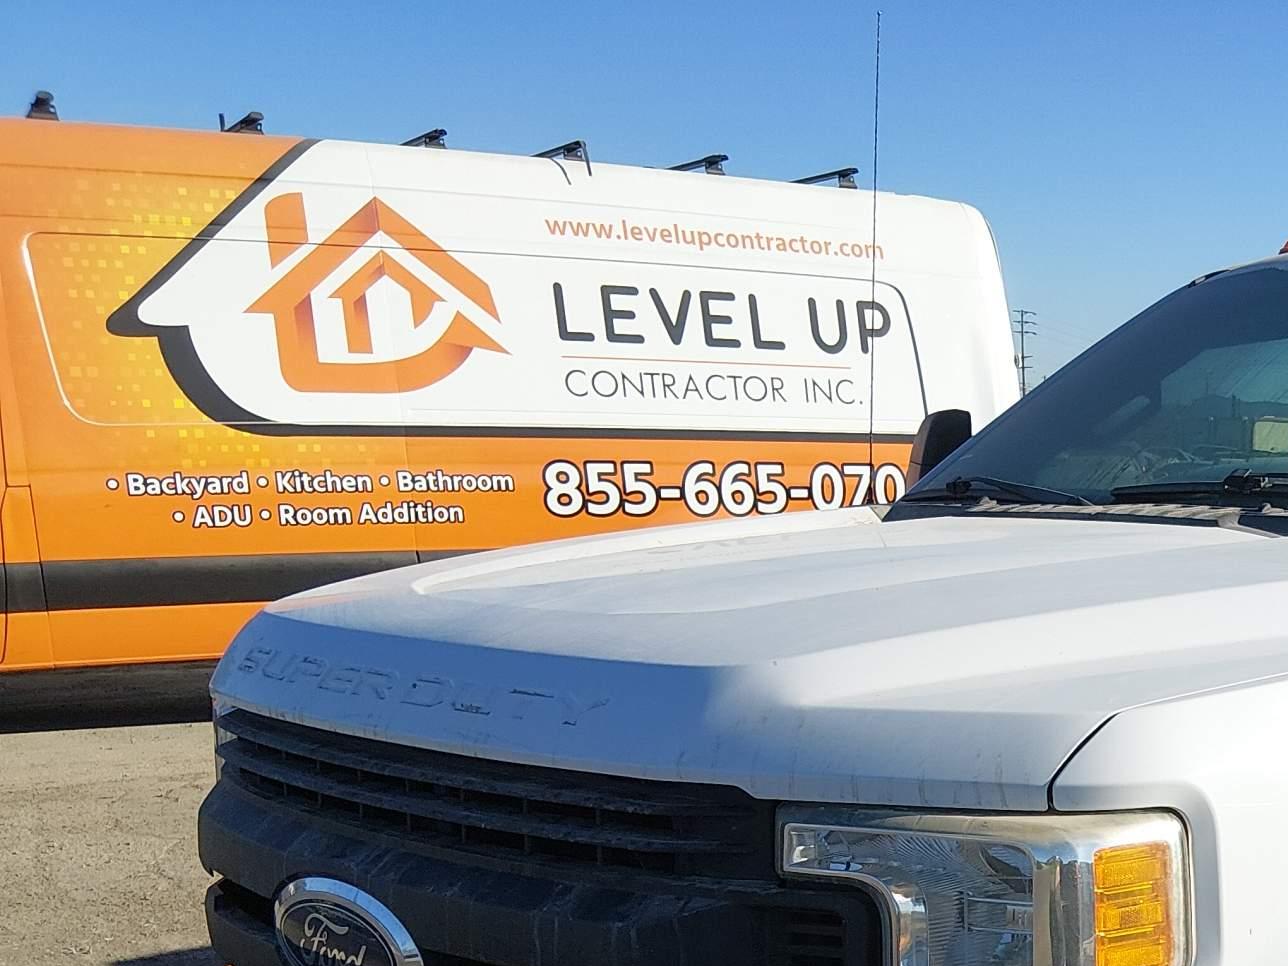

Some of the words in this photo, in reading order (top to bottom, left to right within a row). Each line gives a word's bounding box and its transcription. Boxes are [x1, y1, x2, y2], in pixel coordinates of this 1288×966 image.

[545, 218, 884, 260] www.levelupcontractor.com
[553, 282, 786, 350] LEVEL
[807, 297, 891, 355] UP
[564, 369, 787, 403] CONTRACTOR
[804, 376, 864, 405] INC.
[126, 471, 250, 499] Backyard
[275, 470, 373, 493] Kitchen
[396, 469, 515, 493] Bathroom
[192, 504, 253, 528] ADU
[278, 503, 352, 526] Room
[358, 501, 464, 524] Addition
[237, 647, 401, 702] SUPER
